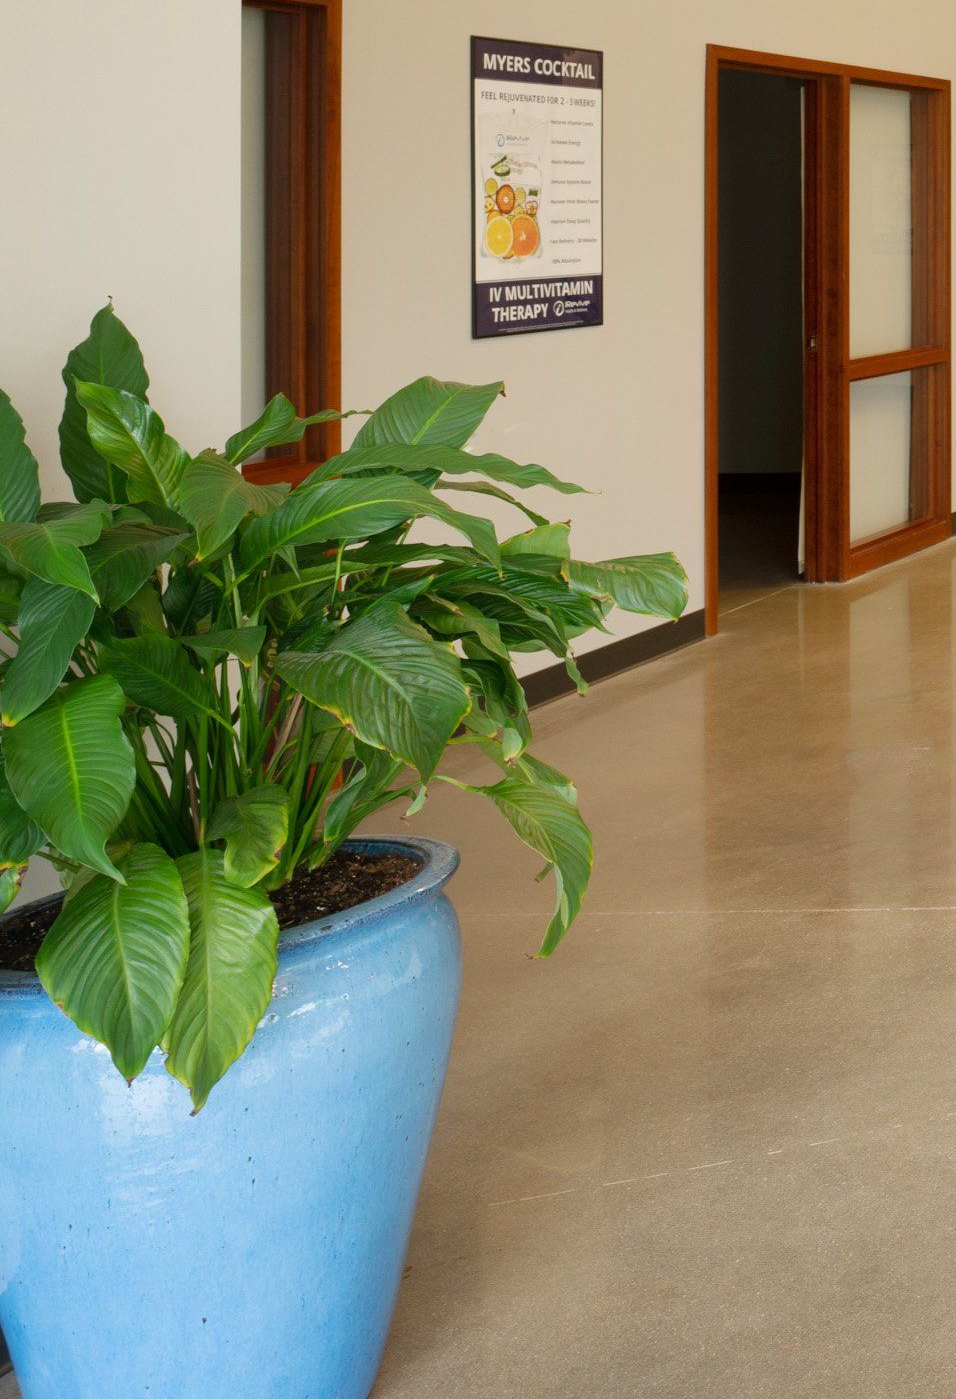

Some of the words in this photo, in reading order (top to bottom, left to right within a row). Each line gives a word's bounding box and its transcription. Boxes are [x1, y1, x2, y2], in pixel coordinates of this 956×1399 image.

[483, 53, 531, 74] MYERS
[534, 58, 596, 80] COCKTAIL
[481, 91, 497, 100] FEEL
[499, 92, 546, 103] REJUVENATED
[547, 96, 559, 104] FOR
[560, 97, 565, 105] 2
[574, 98, 596, 108] WEEKS!
[489, 287, 503, 303] IV
[505, 280, 594, 302] MULTIVITAMIN
[491, 303, 549, 323] THERAPY
